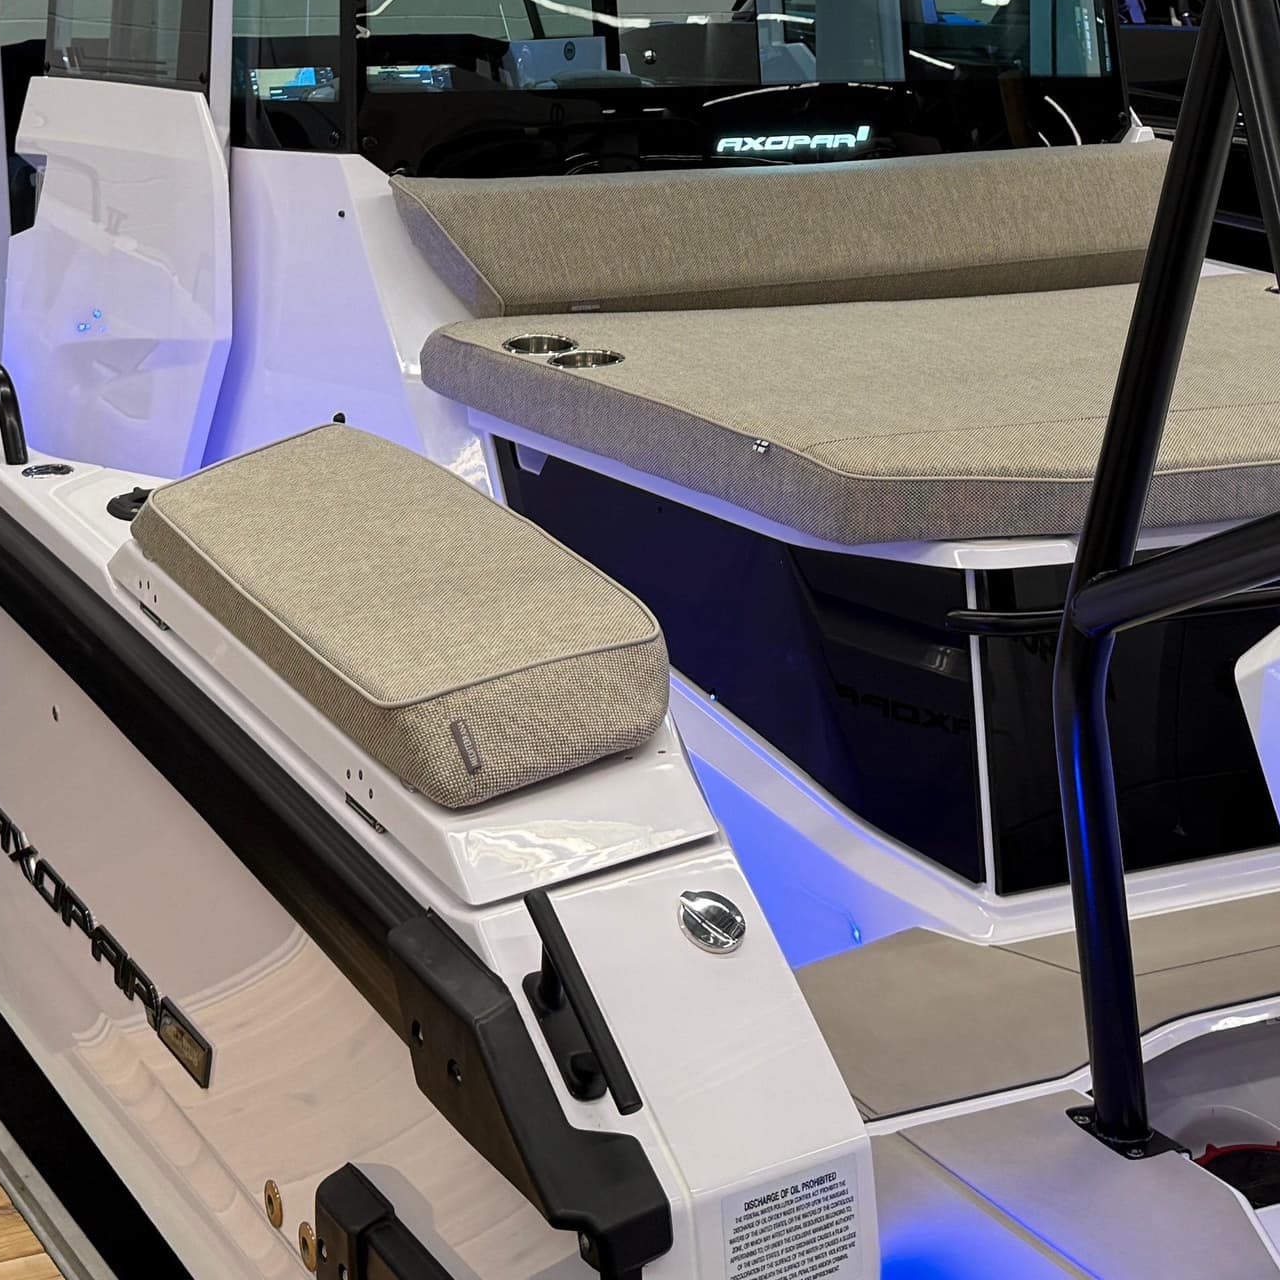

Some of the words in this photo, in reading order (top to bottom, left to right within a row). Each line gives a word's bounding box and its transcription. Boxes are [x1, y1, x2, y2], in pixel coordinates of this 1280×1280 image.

[717, 131, 860, 152] AXOPAR
[744, 1191, 779, 1211] DISCHARGE
[780, 1187, 788, 1199] OF
[790, 1183, 800, 1195] OIL
[802, 1172, 836, 1190] PROHIBITED
